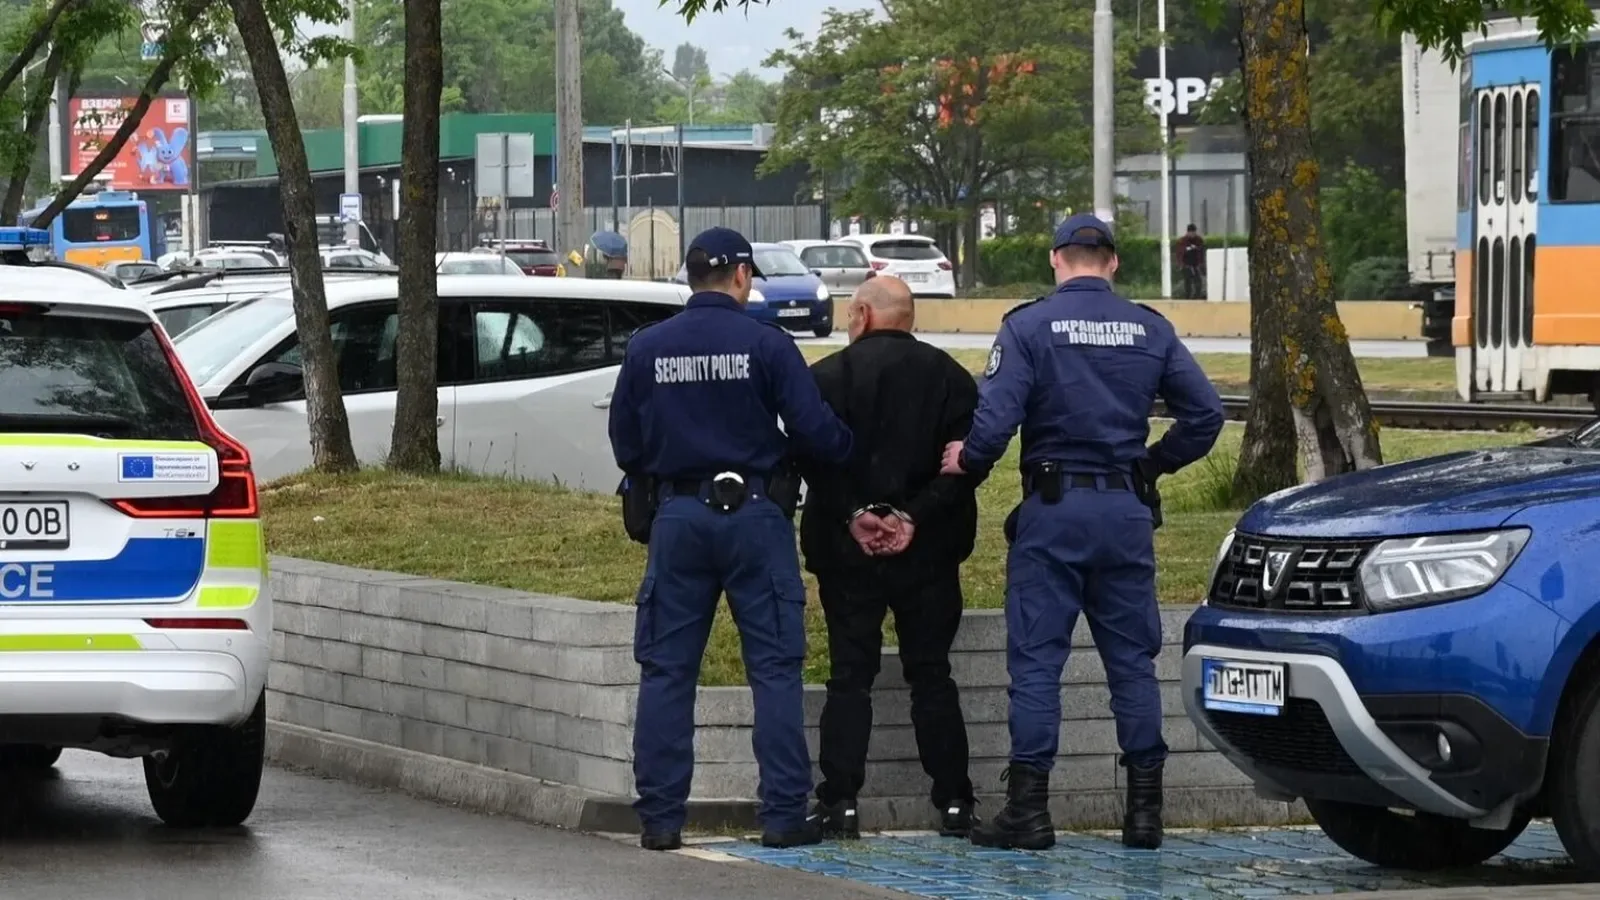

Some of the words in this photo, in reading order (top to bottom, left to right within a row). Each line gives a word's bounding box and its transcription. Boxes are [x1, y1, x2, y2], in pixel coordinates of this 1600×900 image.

[1051, 320, 1146, 336] ОХРАНИТЕЛНА
[1069, 332, 1134, 347] ПОЛИЦИЯ
[655, 356, 709, 384] SECURITY
[711, 354, 750, 381] POLICE
[0, 563, 54, 598] CE
